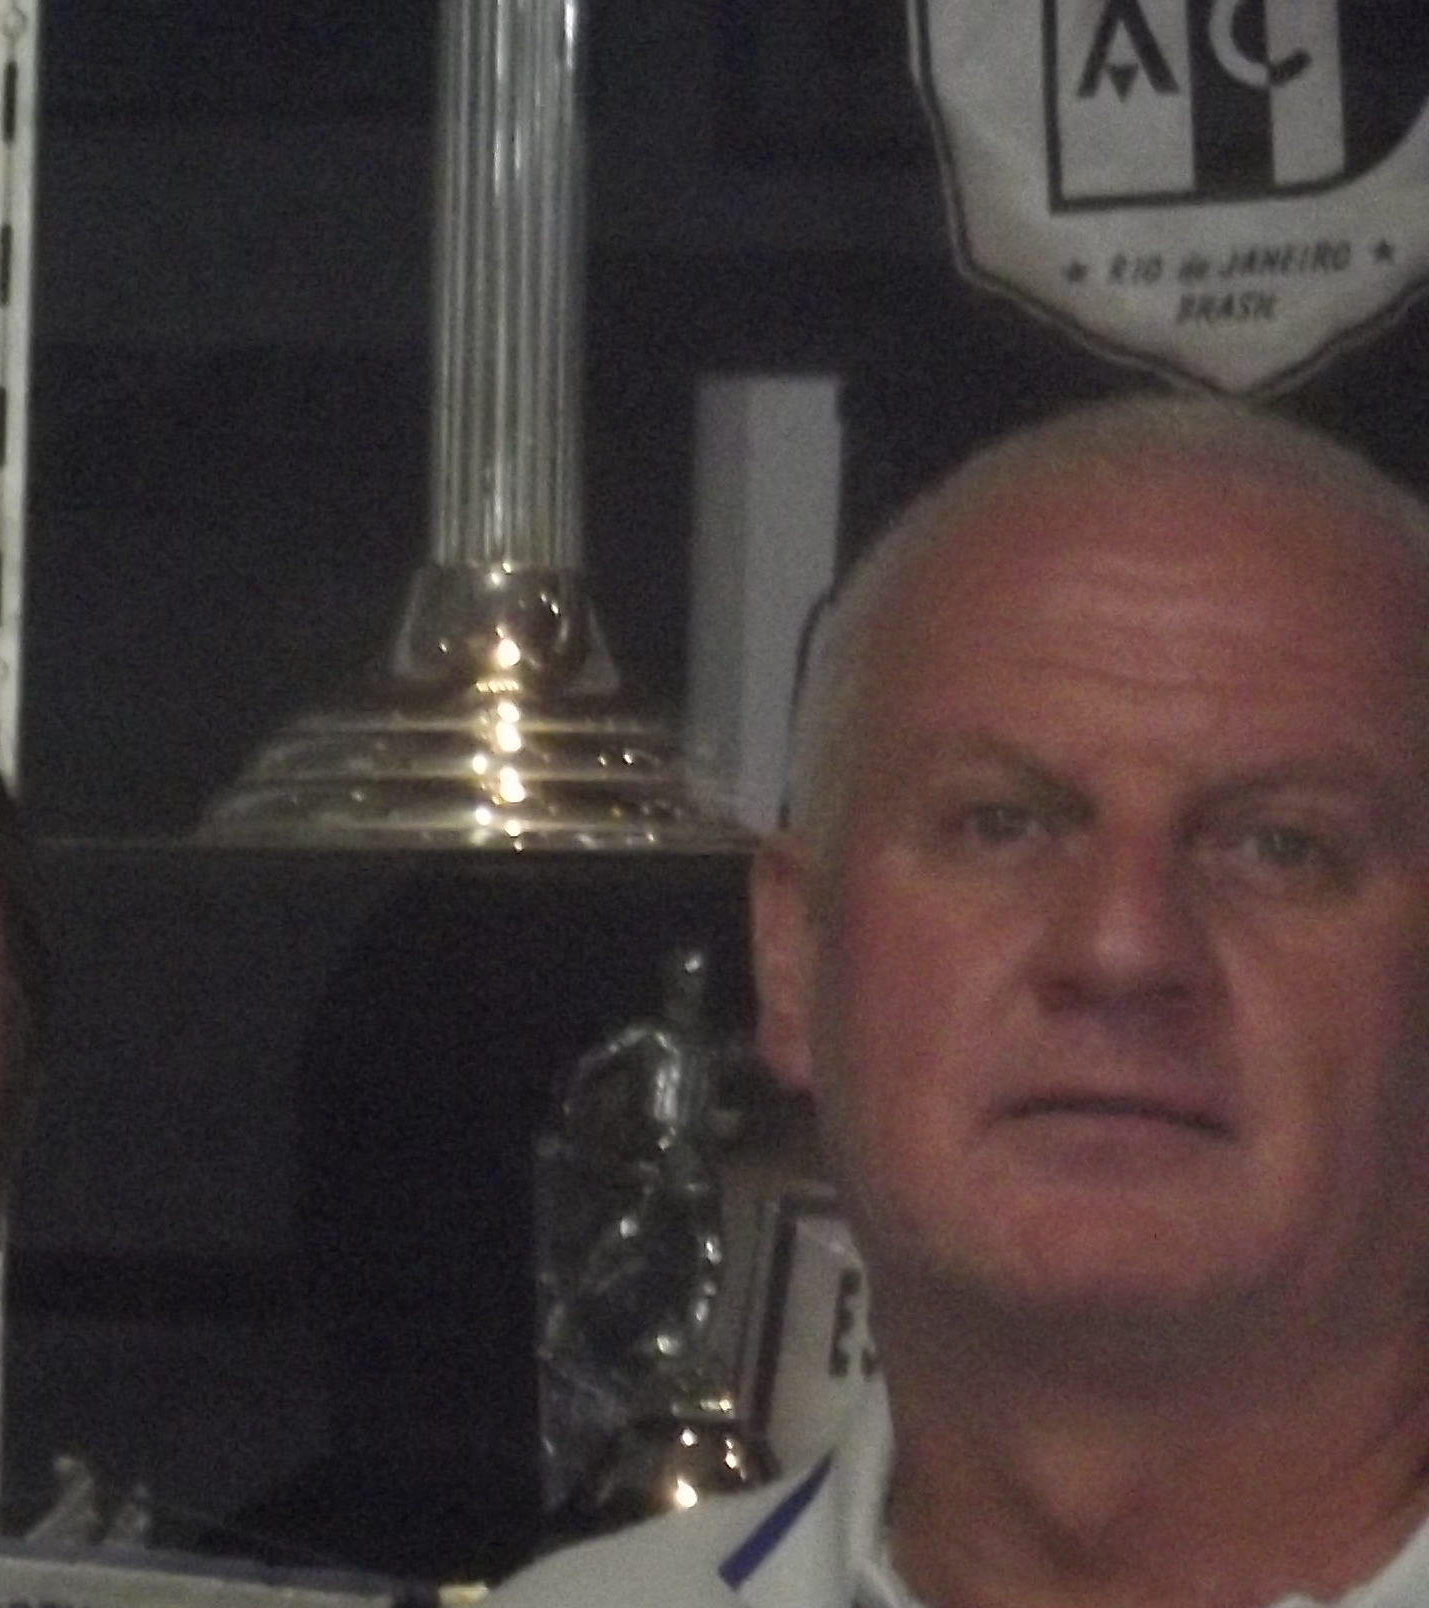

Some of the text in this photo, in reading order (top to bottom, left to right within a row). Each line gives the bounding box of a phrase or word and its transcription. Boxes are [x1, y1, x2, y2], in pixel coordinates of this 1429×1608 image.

[1107, 252, 1162, 286] RIO
[1217, 239, 1352, 278] JANEIRO
[1175, 291, 1277, 325] BRASIL
